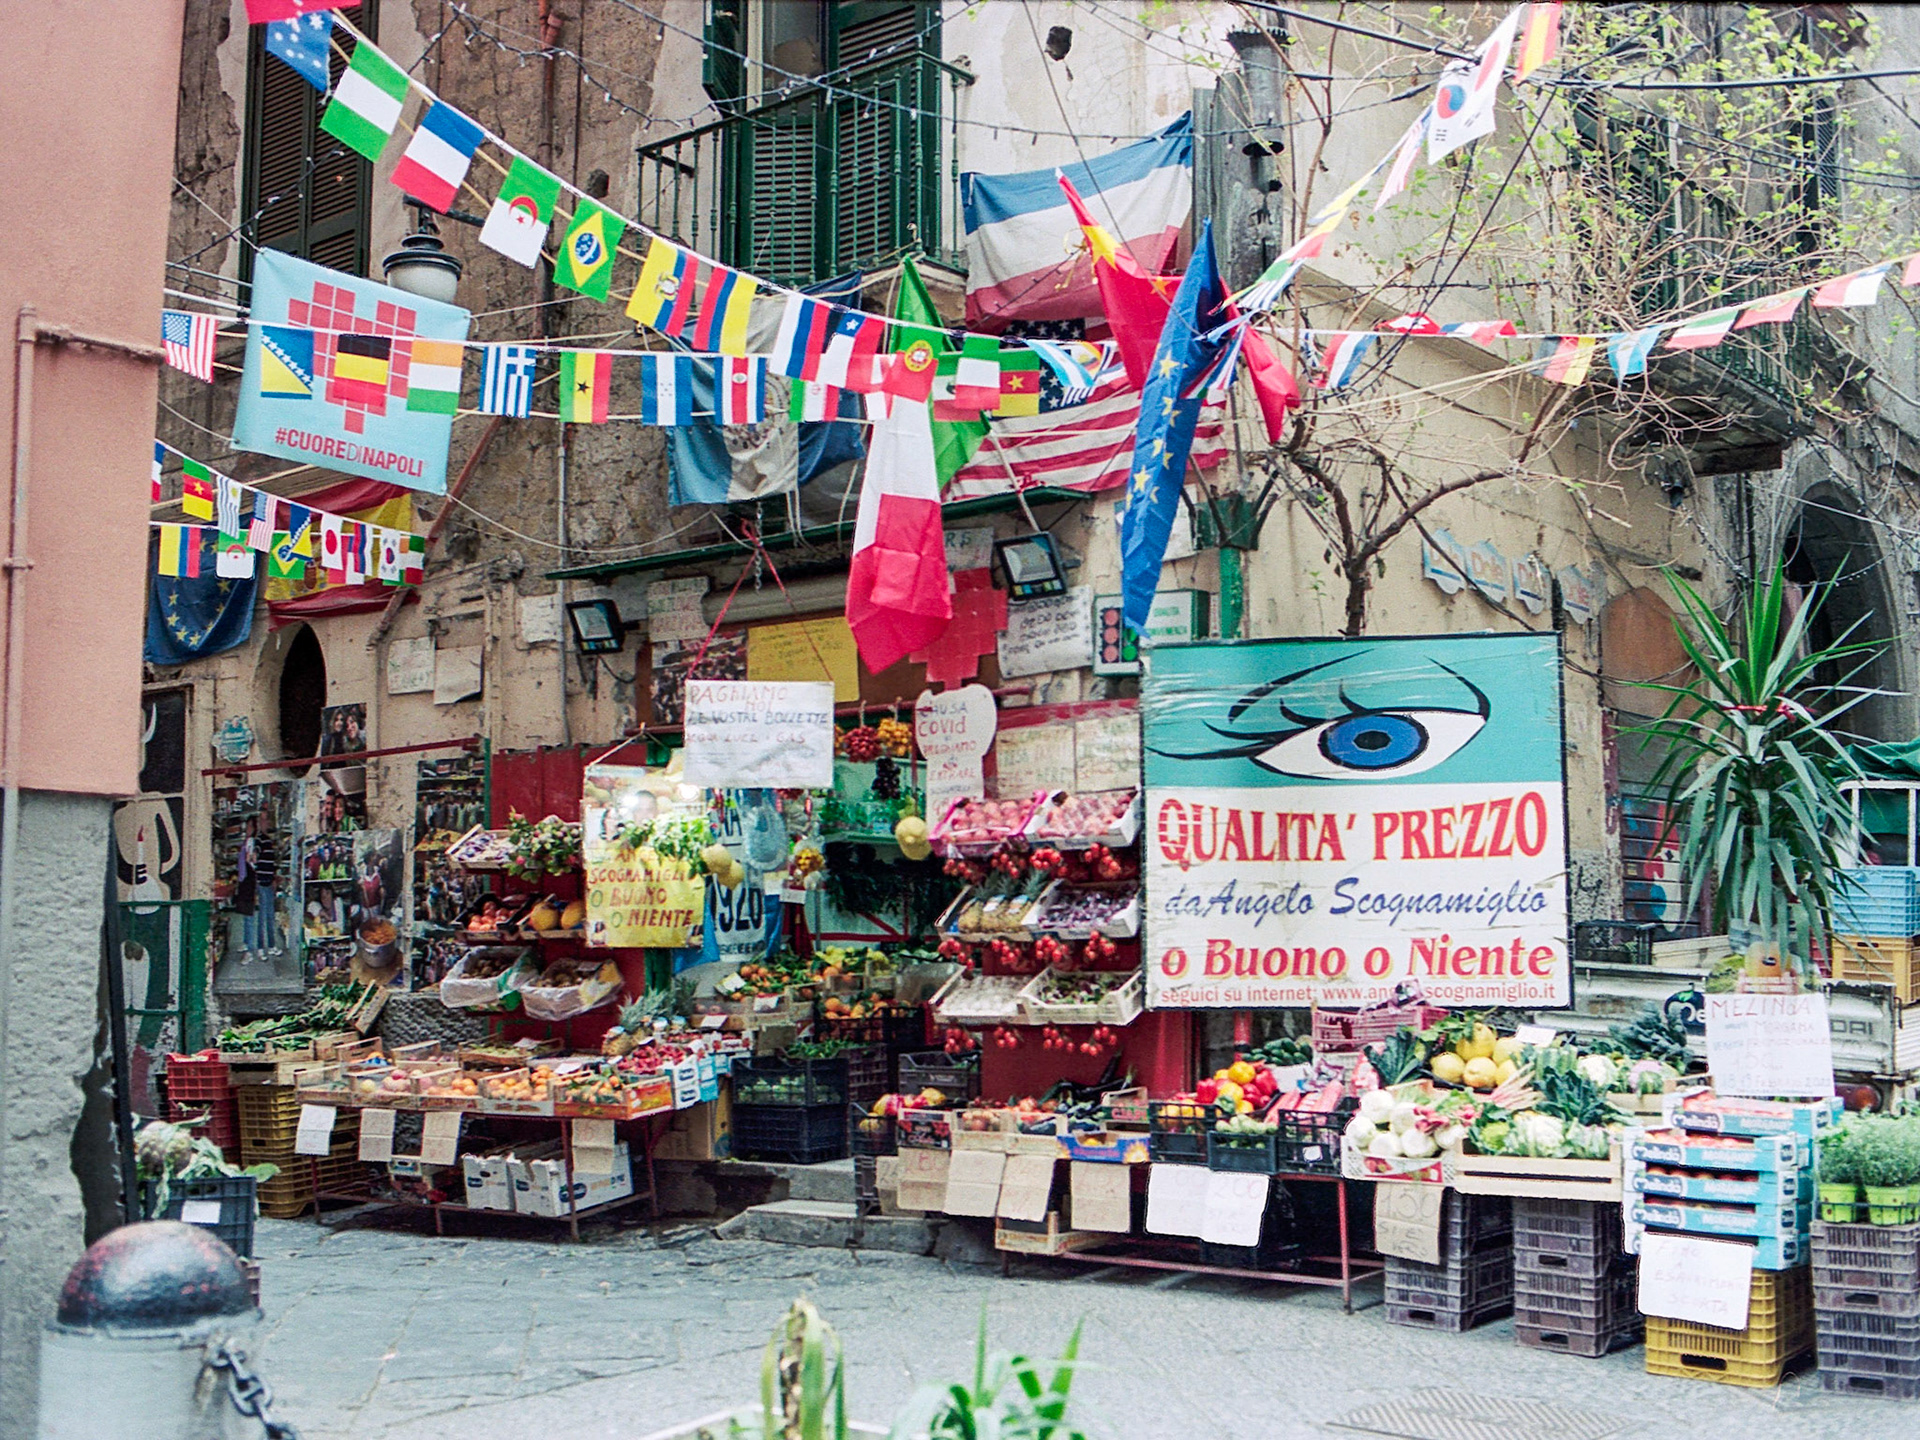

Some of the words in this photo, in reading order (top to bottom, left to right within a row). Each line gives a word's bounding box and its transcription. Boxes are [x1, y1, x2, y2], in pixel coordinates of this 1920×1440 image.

[275, 427, 424, 477] #CUOREDINAPOLI
[690, 685, 788, 704] PAGHIAMO
[1158, 798, 1356, 872] QUALITA'
[1372, 791, 1548, 861] PREZZO
[589, 868, 694, 884] SCOGNAMIGLI
[1329, 876, 1548, 927] Scognamiglio
[627, 908, 694, 928] NIENTE
[1161, 946, 1188, 978] o
[1203, 938, 1347, 978] Buono
[1363, 946, 1392, 977] o
[1406, 933, 1555, 978] Niente
[1161, 986, 1219, 1005] seguici
[1224, 989, 1242, 1001] su
